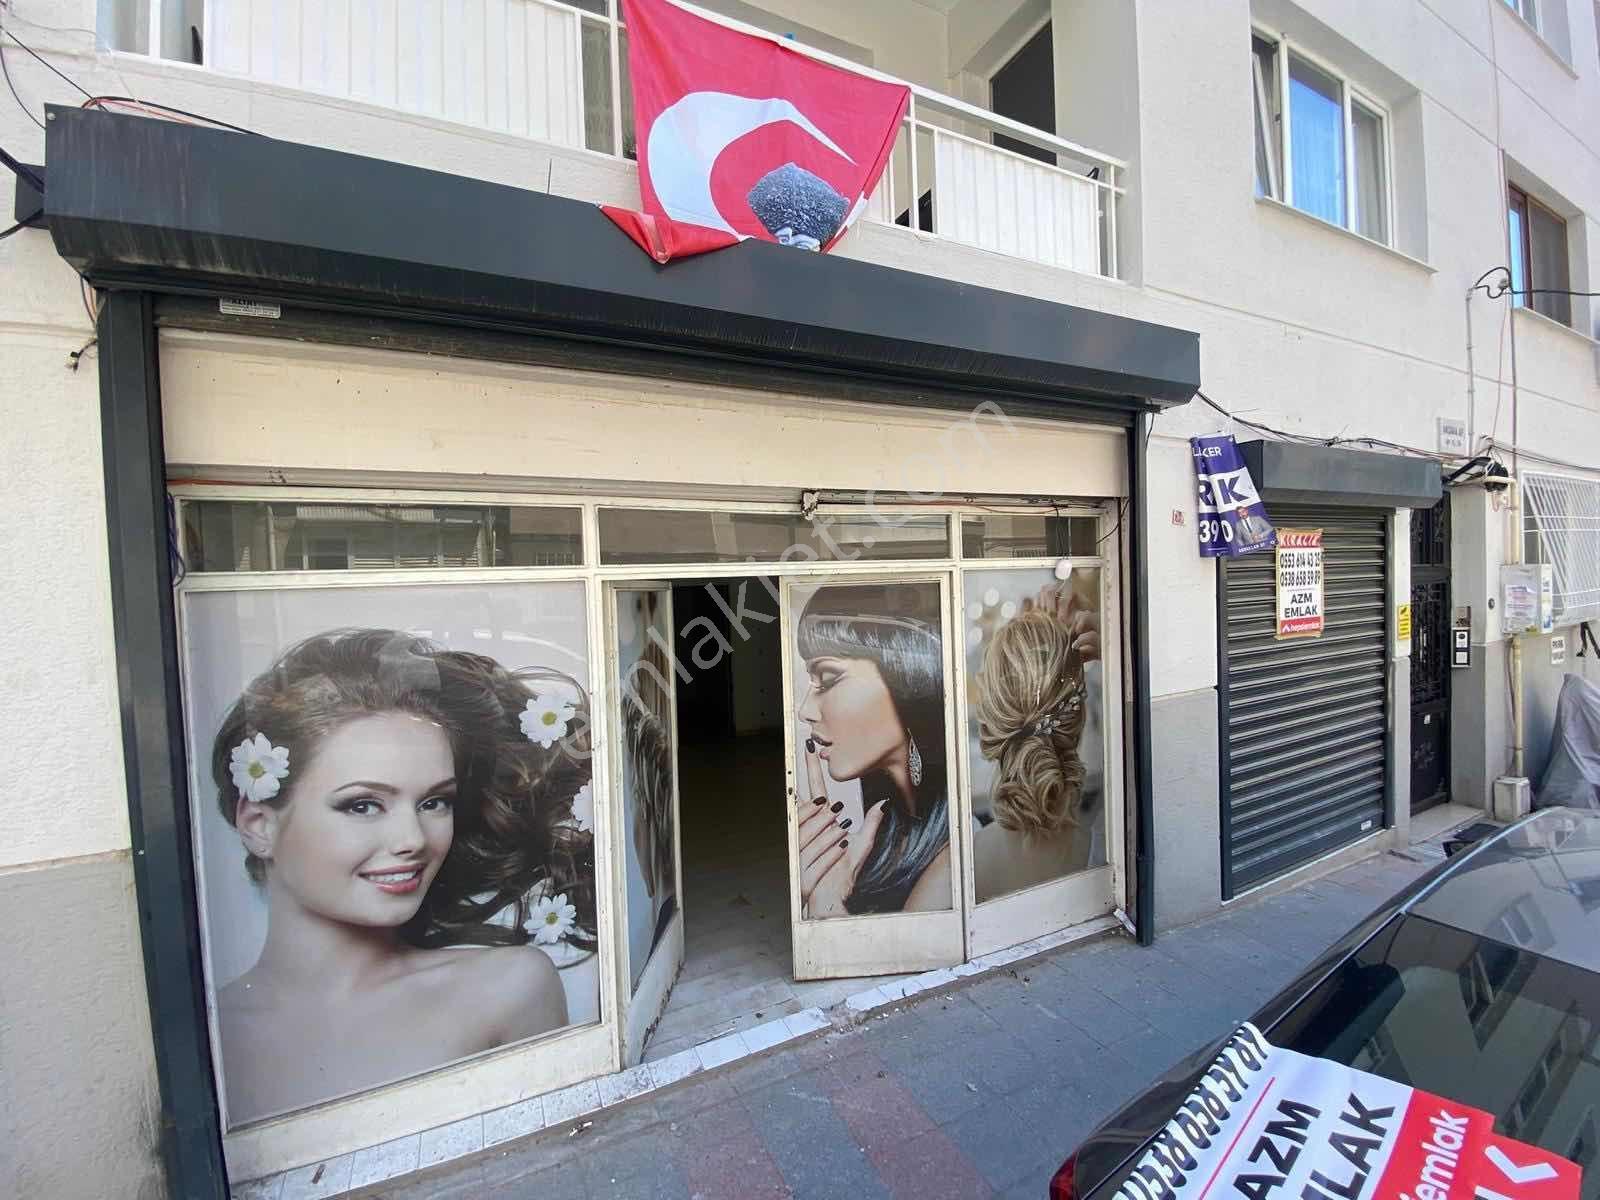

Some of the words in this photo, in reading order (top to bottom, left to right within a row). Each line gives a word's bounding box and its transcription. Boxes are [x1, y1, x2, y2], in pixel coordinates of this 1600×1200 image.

[1290, 593, 1313, 604] AZM
[1284, 605, 1318, 618] EMLAK
[1233, 1099, 1321, 1200] AZM
